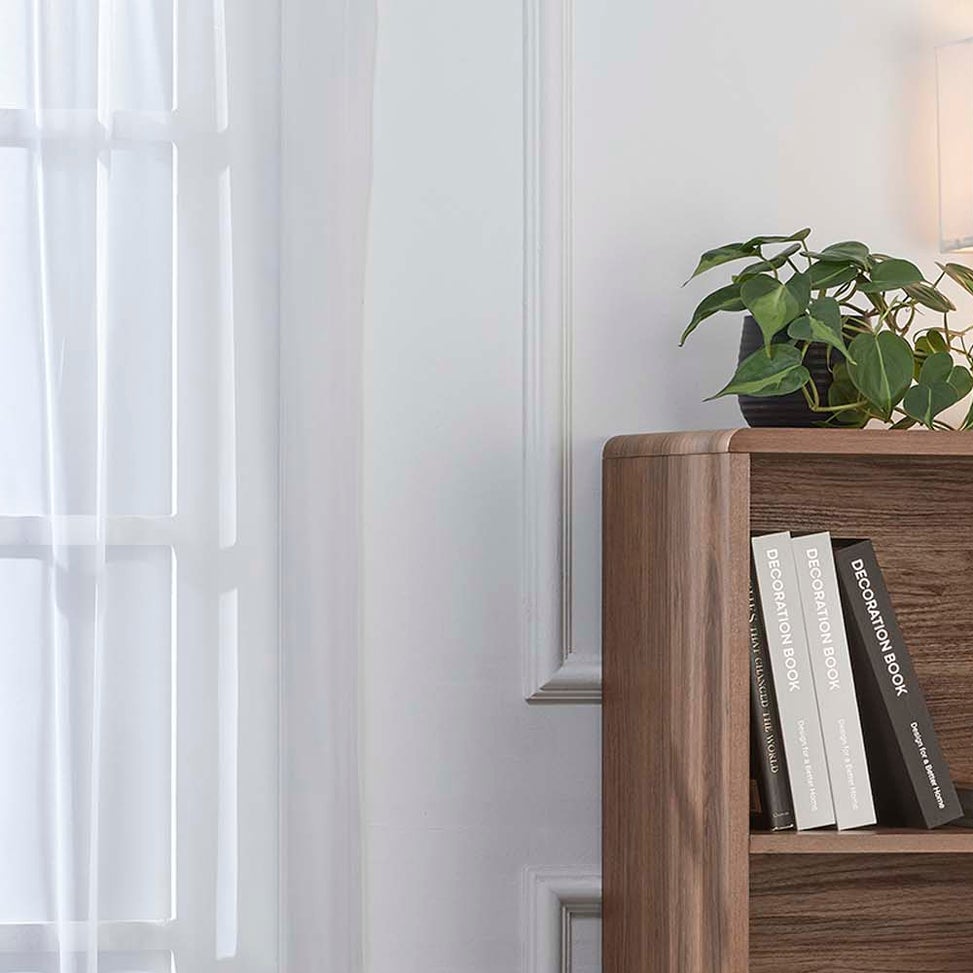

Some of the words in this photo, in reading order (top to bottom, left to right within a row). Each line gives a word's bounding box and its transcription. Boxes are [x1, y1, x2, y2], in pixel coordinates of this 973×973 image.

[750, 628, 760, 654] THAT
[766, 548, 793, 645] DECORATION
[783, 647, 801, 692] BOOK
[806, 548, 833, 645] DECORATION
[823, 646, 840, 691] BOOK
[851, 558, 893, 652] DECORATION
[883, 653, 908, 697] BOOK
[754, 657, 769, 708] CHANGED
[763, 712, 772, 732] THE
[765, 734, 779, 774] WORLD
[910, 722, 923, 747] Design
[919, 747, 928, 758] for
[925, 764, 937, 786] Better
[933, 786, 945, 809] Home
